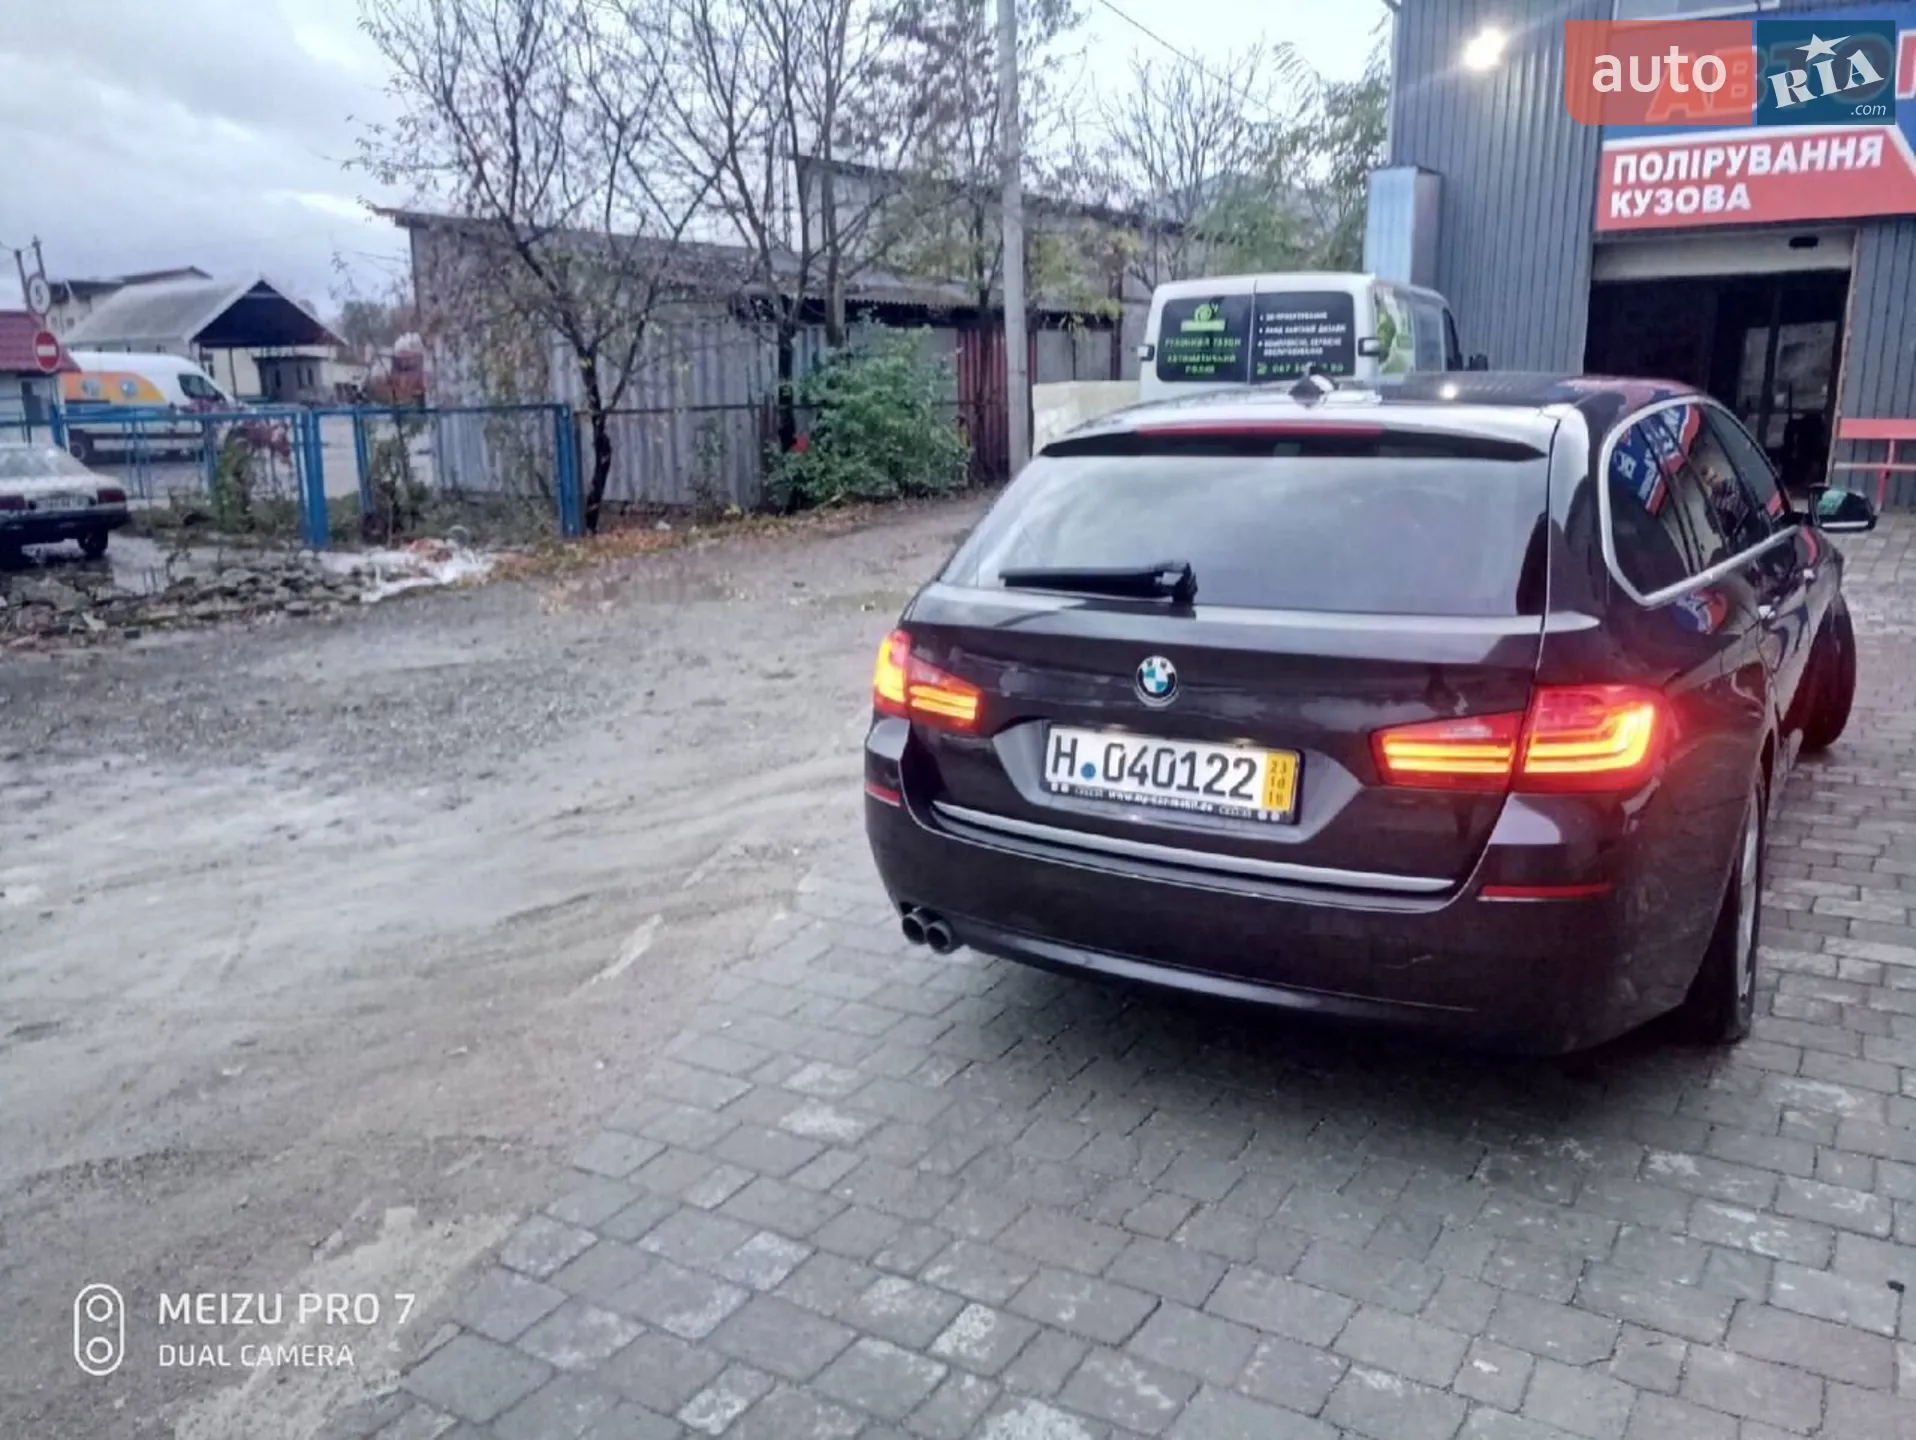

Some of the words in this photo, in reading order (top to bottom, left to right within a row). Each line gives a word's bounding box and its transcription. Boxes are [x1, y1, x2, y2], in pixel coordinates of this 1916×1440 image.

[1613, 135, 1884, 185] ПОЛІРУВАННЯ
[1610, 183, 1751, 218] КУЗОВА
[1052, 735, 1078, 777] H
[1103, 742, 1257, 801] 040122
